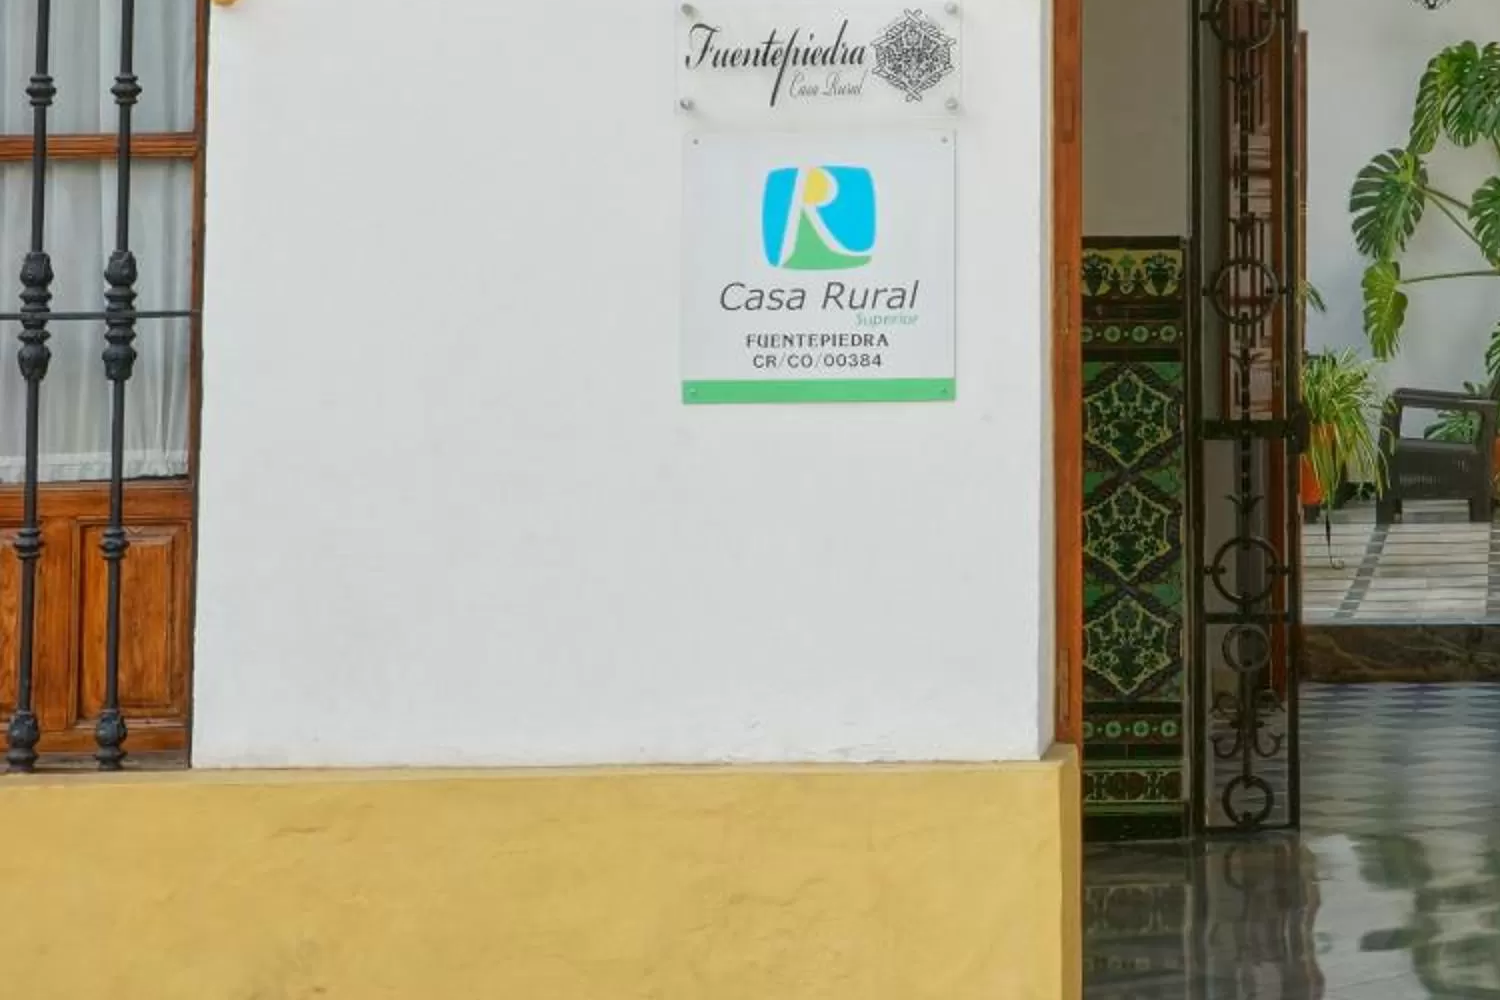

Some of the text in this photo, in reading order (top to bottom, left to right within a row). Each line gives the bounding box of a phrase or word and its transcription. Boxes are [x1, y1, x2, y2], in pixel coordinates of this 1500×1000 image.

[684, 19, 866, 107] Fuentepiedra
[719, 280, 919, 311] Casa Rural
[856, 312, 918, 327] Superior
[746, 333, 889, 349] FUENTEPIEDRA
[752, 353, 882, 369] CR/CO/00384
